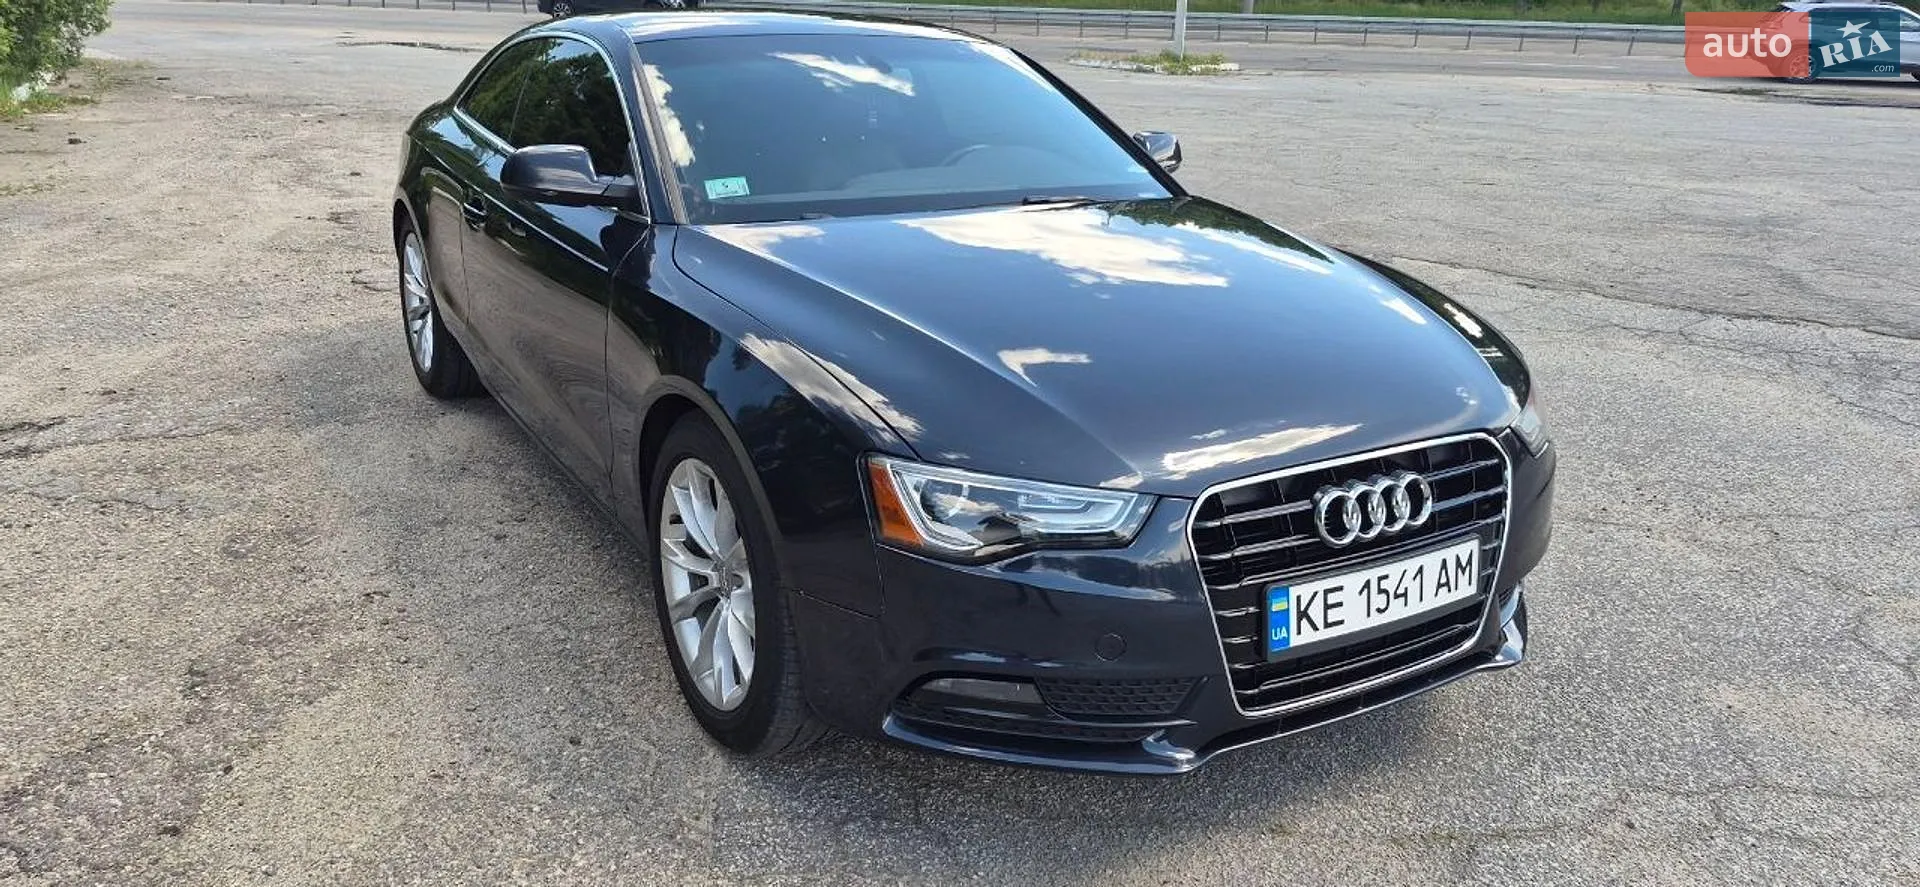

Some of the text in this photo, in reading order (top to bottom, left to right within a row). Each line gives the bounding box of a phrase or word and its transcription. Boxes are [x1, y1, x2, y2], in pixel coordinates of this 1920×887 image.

[1295, 549, 1474, 636] KE 1541 AM
[1271, 626, 1288, 641] UA
